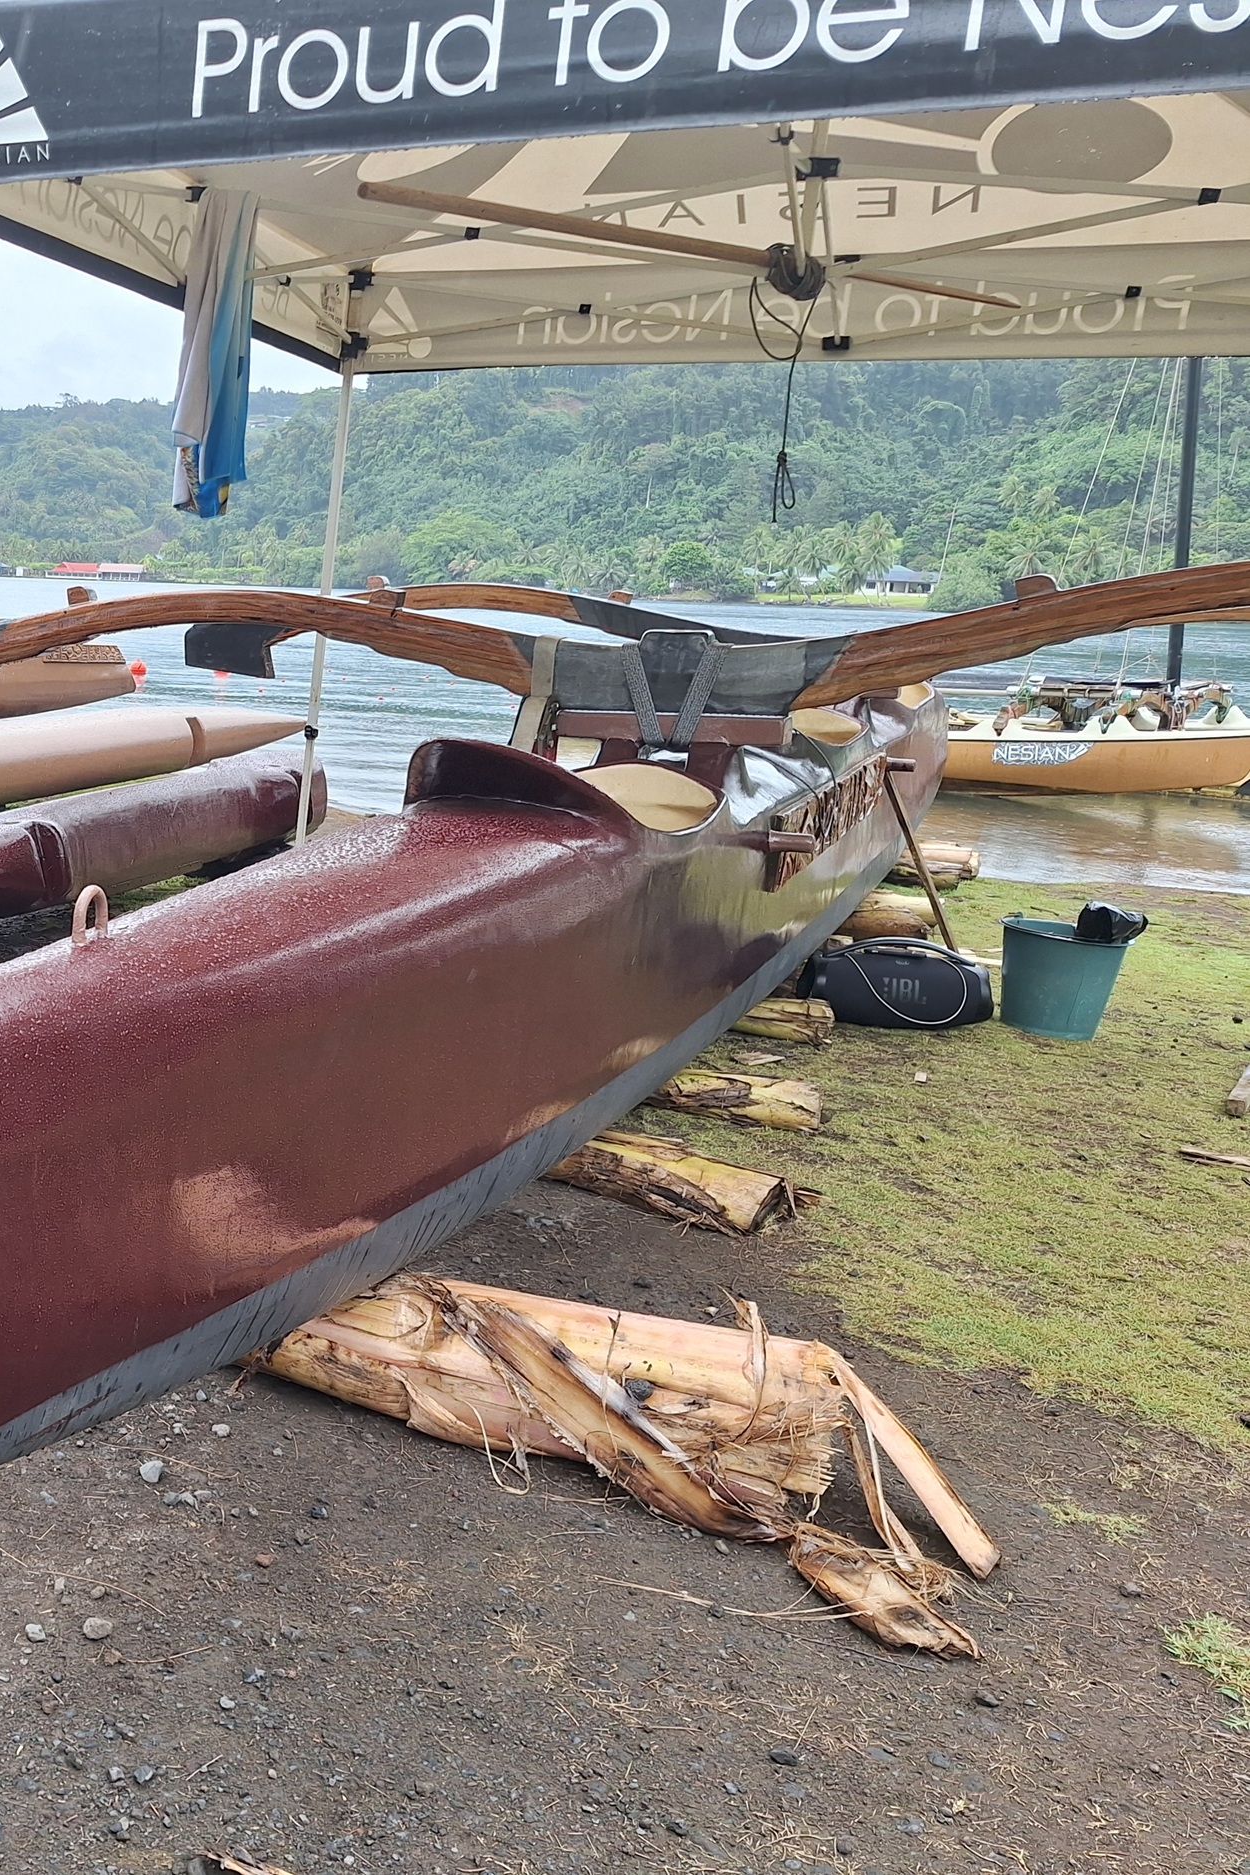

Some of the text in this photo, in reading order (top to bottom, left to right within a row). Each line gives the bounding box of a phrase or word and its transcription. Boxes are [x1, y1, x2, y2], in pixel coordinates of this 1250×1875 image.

[192, 0, 506, 118] Proud
[548, 0, 671, 86] to
[716, 0, 910, 73] be
[992, 745, 1071, 761] NESIAN
